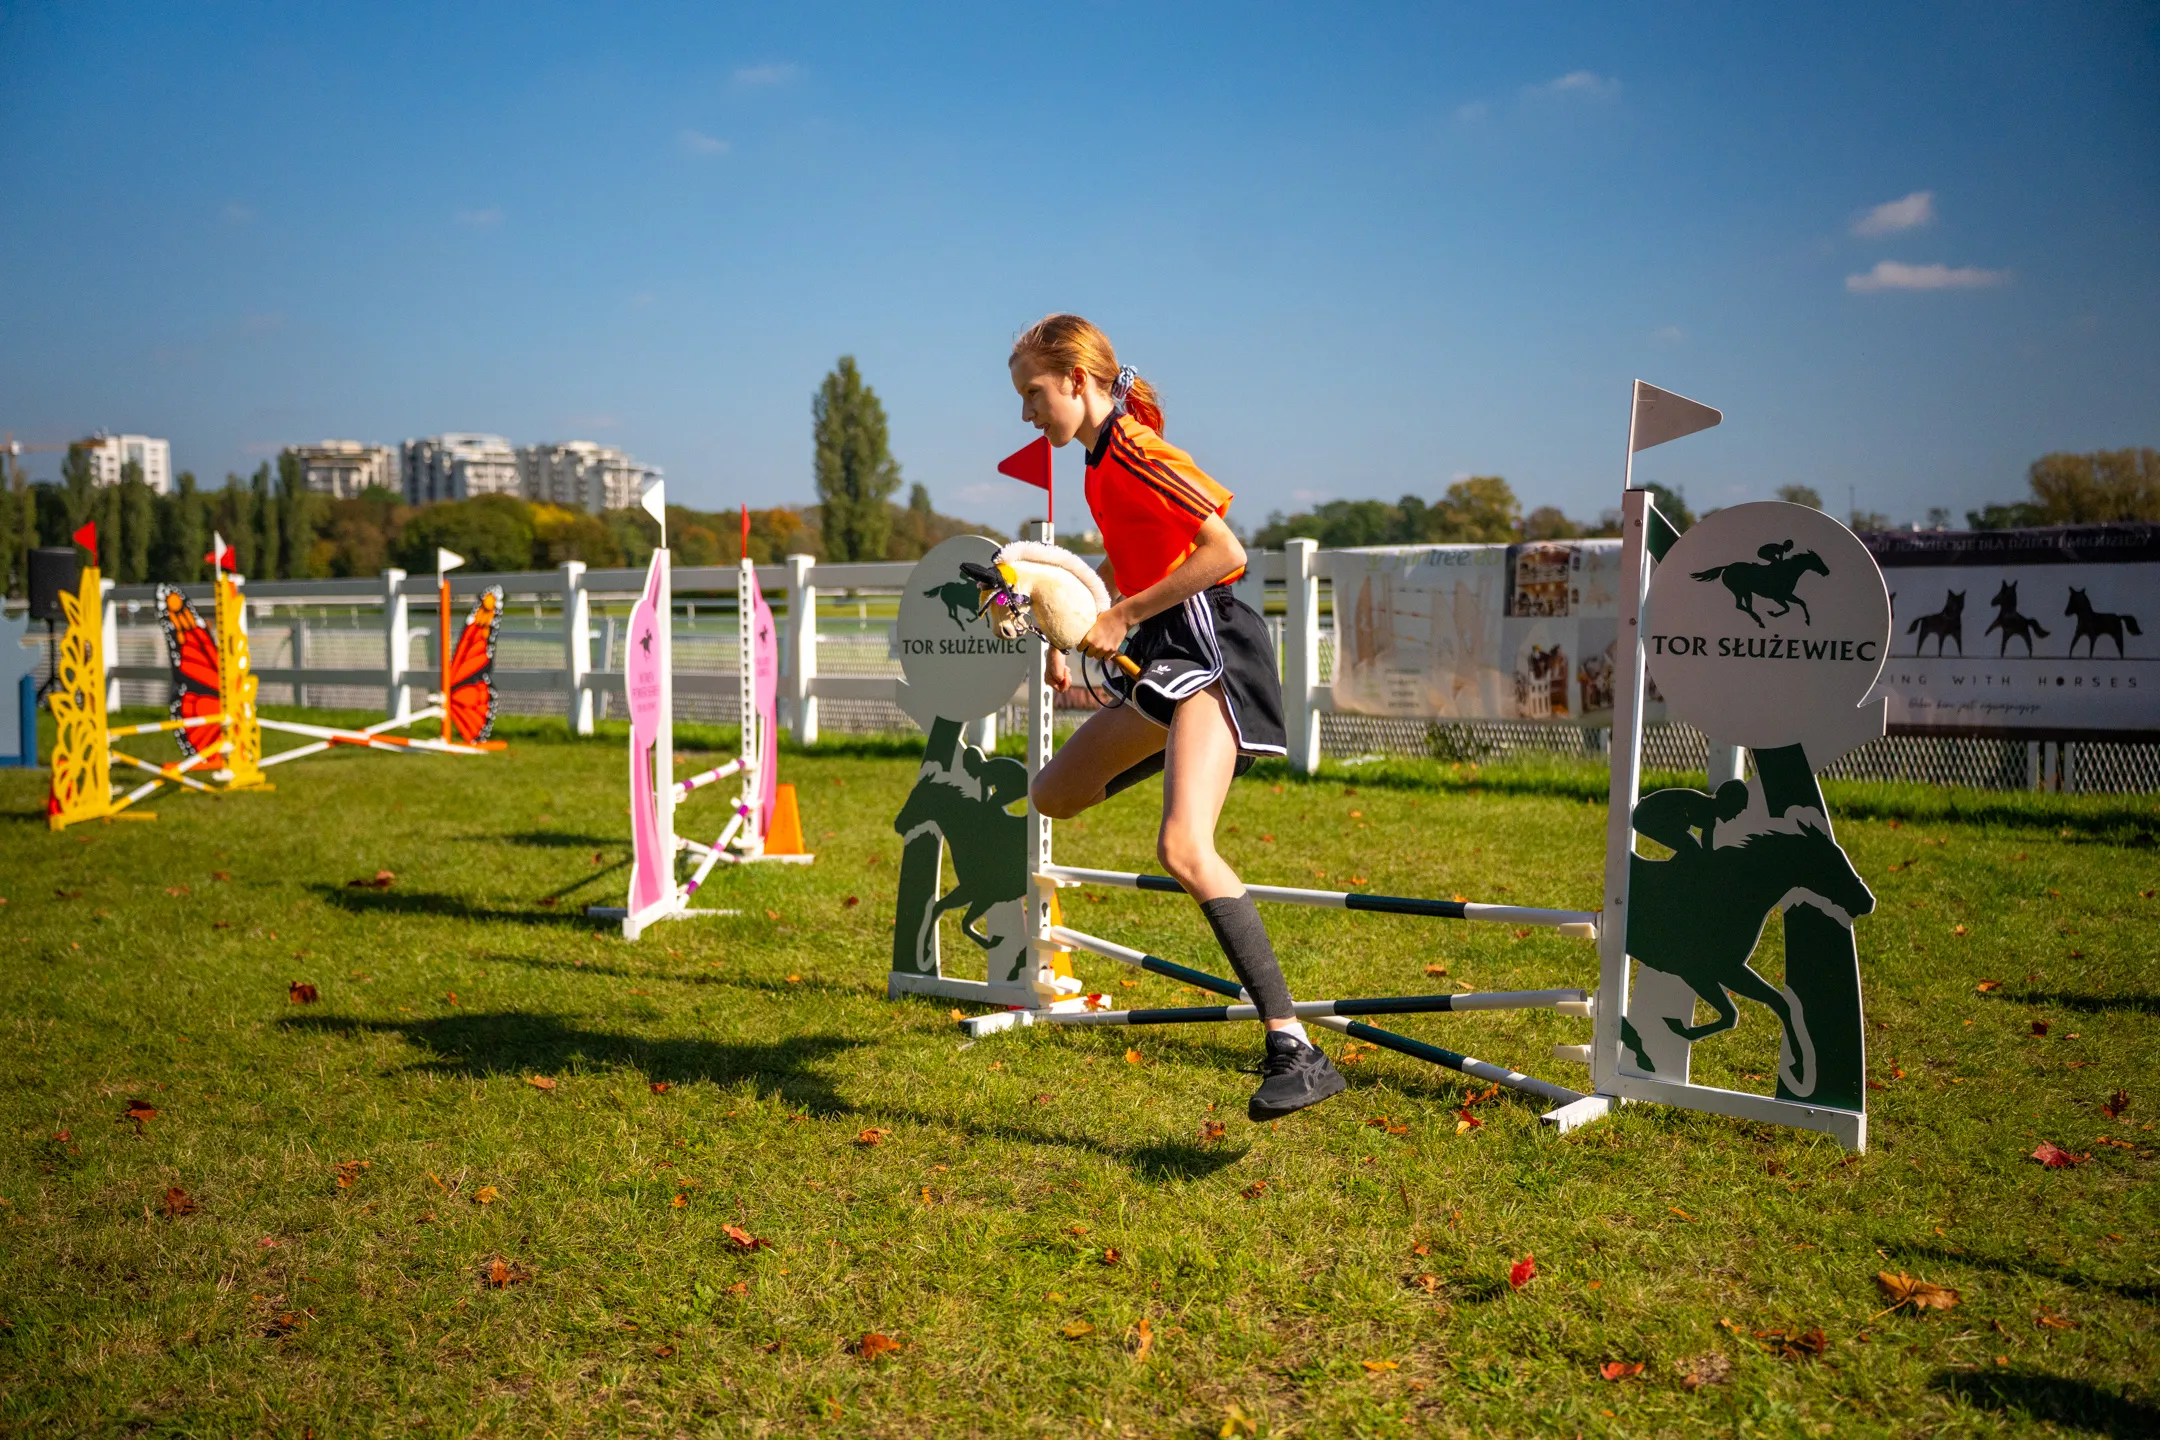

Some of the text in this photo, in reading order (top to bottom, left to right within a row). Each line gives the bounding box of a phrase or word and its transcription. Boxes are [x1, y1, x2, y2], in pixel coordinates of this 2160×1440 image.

[903, 635, 1027, 655] TOR SŁUŻEWIEC
[1652, 634, 1876, 662] TOR SŁUŻEWIEC
[1952, 675, 2010, 686] WITH
